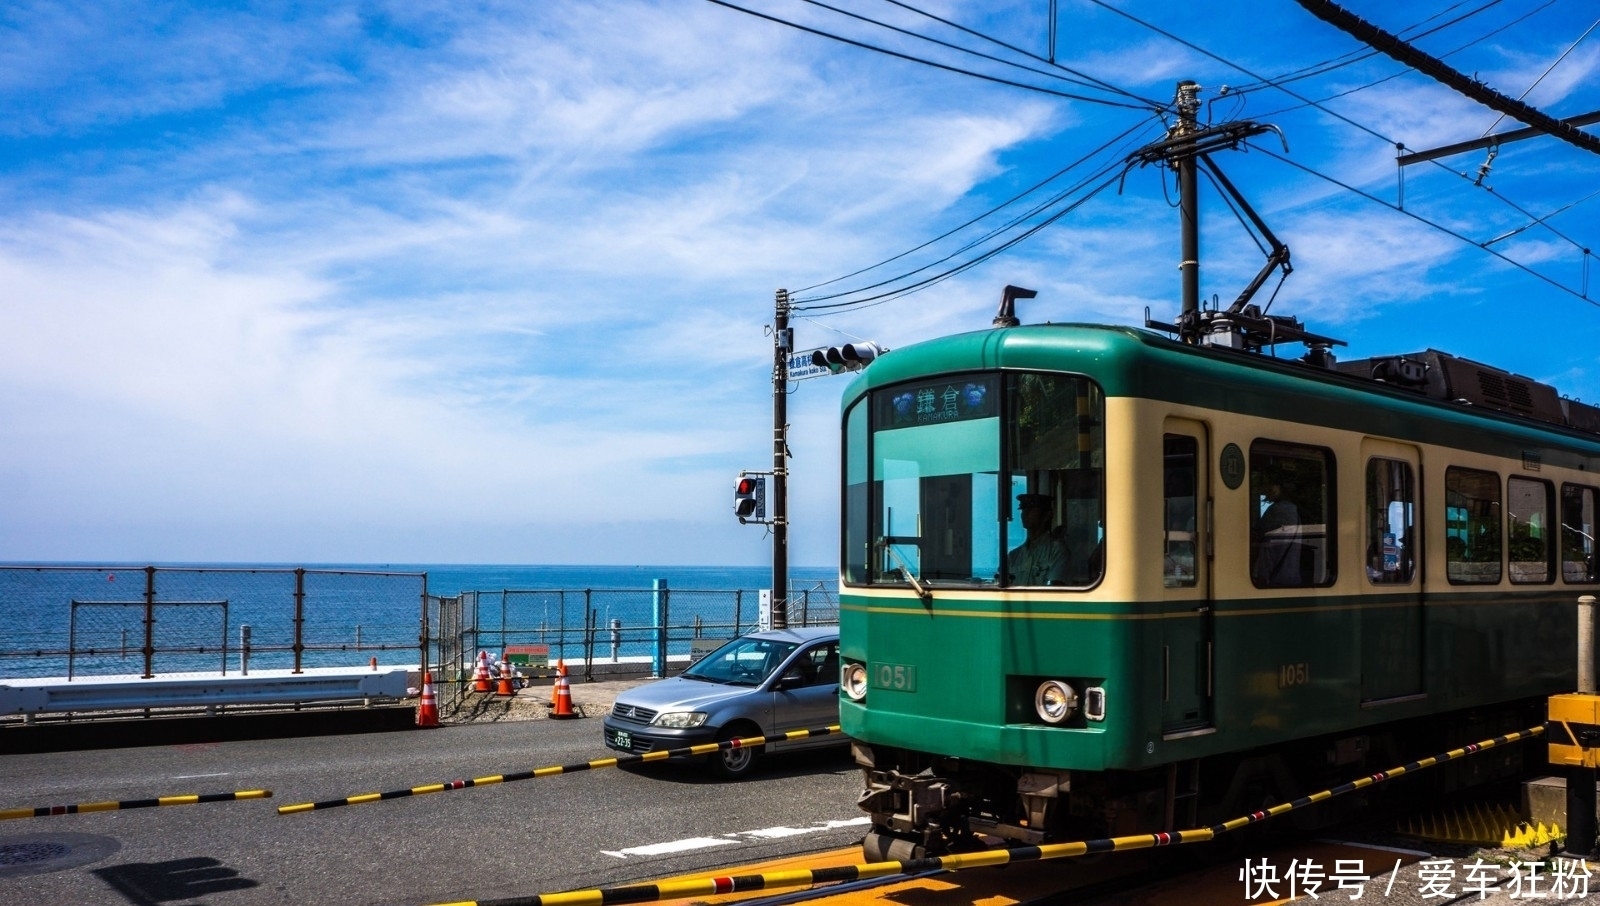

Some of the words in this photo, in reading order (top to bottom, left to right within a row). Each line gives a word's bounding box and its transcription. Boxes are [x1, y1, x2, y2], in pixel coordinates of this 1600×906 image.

[917, 385, 960, 413] 鎌倉
[917, 410, 959, 422] KAMAKURA
[874, 664, 913, 689] 1051
[1281, 662, 1309, 687] 1051
